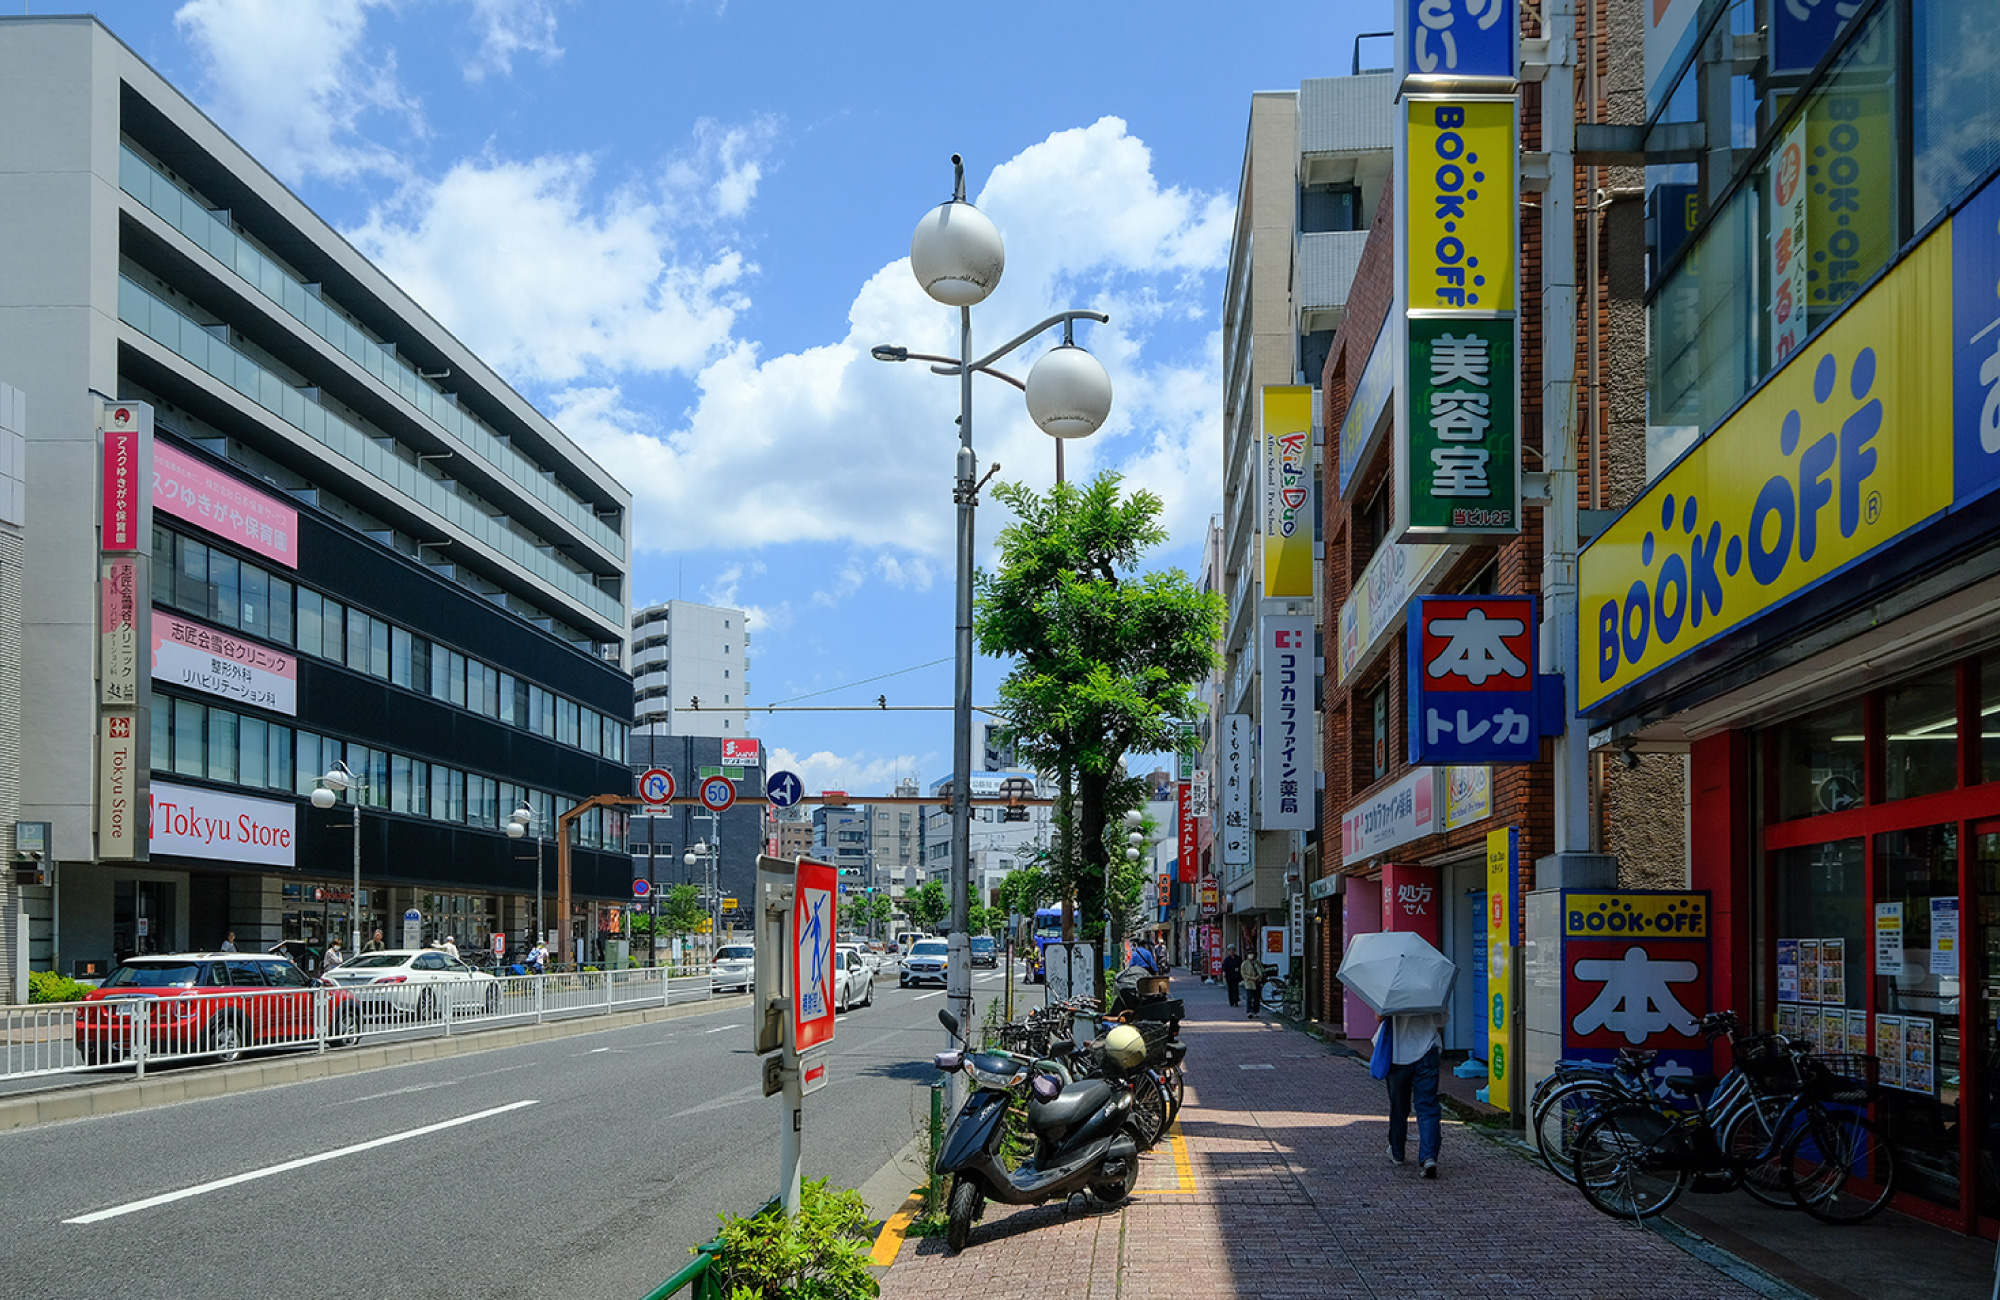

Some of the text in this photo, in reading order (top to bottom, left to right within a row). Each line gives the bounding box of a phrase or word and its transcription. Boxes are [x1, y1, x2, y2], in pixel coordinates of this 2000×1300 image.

[1430, 332, 1491, 496] 美容室
[116, 436, 128, 544] アスクゆきがや保育園
[1453, 508, 1511, 526] 当ビル2F
[171, 622, 286, 673] 志匠会雪谷クリニック
[1427, 608, 1528, 685] 本
[182, 669, 276, 707] リハビリテーション科
[211, 658, 252, 684] 整形外科
[1280, 654, 1298, 814] ココカラファイン薬局
[1427, 708, 1529, 744] トレカ
[111, 747, 128, 839] Tokyu Store
[708, 785, 728, 802] 50
[25, 825, 35, 839] P
[158, 802, 291, 848] Tokyu Store
[1397, 884, 1433, 903] 処方
[1403, 903, 1427, 915] せん
[1572, 945, 1700, 1045] 本
